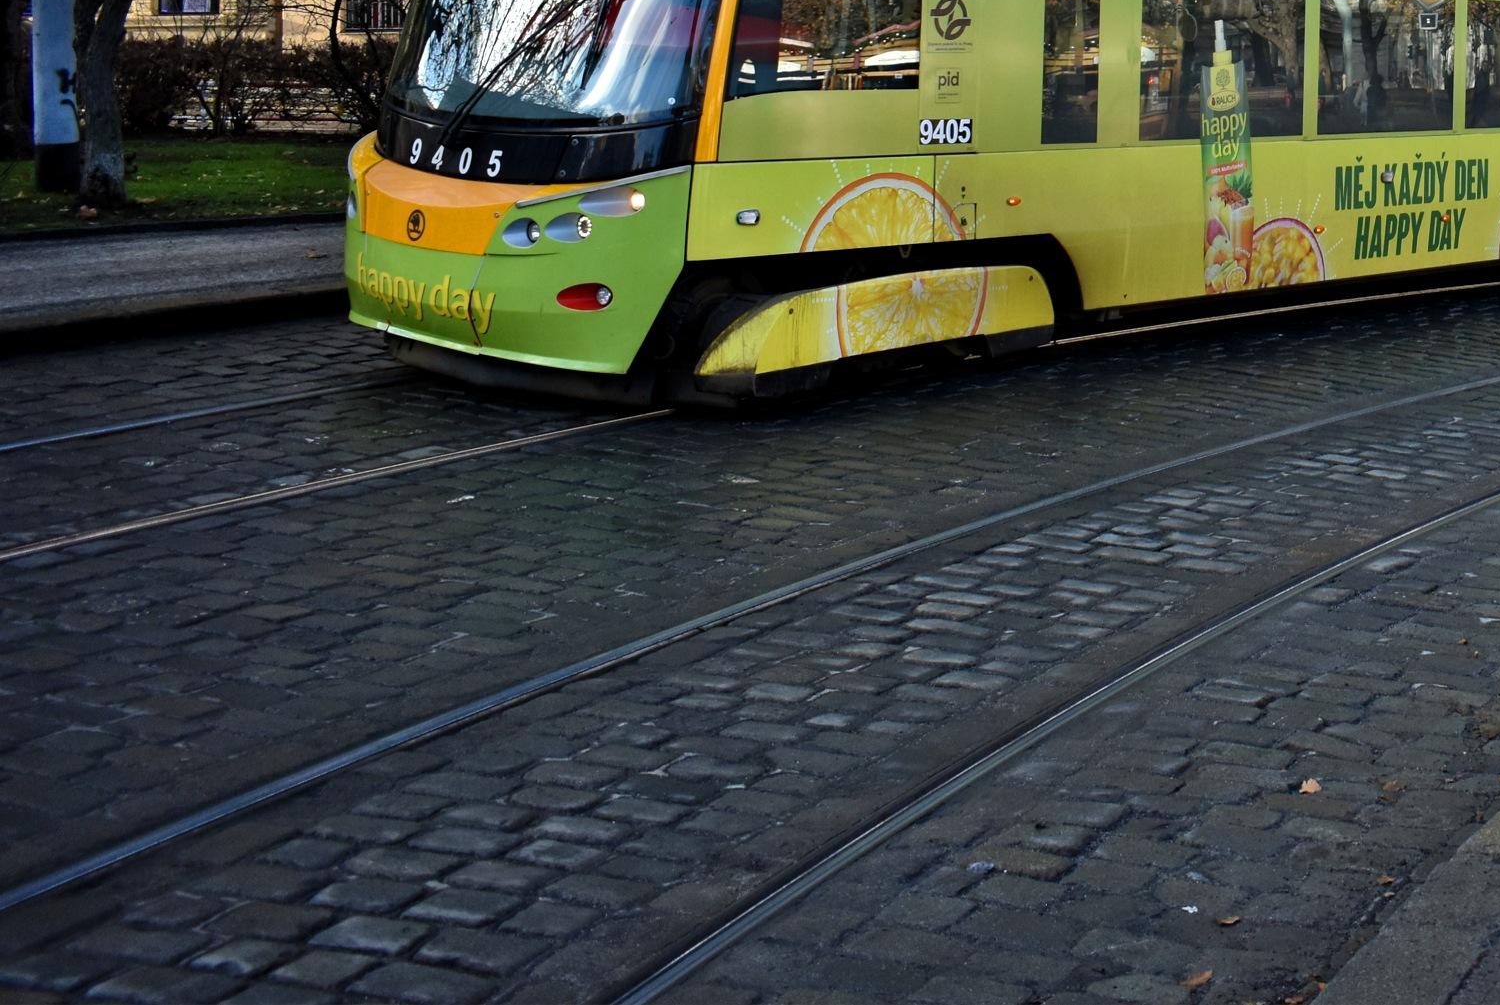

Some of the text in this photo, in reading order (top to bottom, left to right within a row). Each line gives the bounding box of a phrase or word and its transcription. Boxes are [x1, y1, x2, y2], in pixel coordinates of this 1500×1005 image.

[938, 71, 960, 91] pid
[1216, 95, 1237, 106] RAUCH
[919, 118, 972, 145] 9405
[1201, 112, 1248, 139] happy
[410, 137, 504, 178] 9405
[1211, 135, 1240, 161] day
[1334, 151, 1489, 211] MĚJ KAŽDÝ DEN
[1354, 207, 1467, 260] HAPPY DAY
[357, 251, 497, 335] happy day
